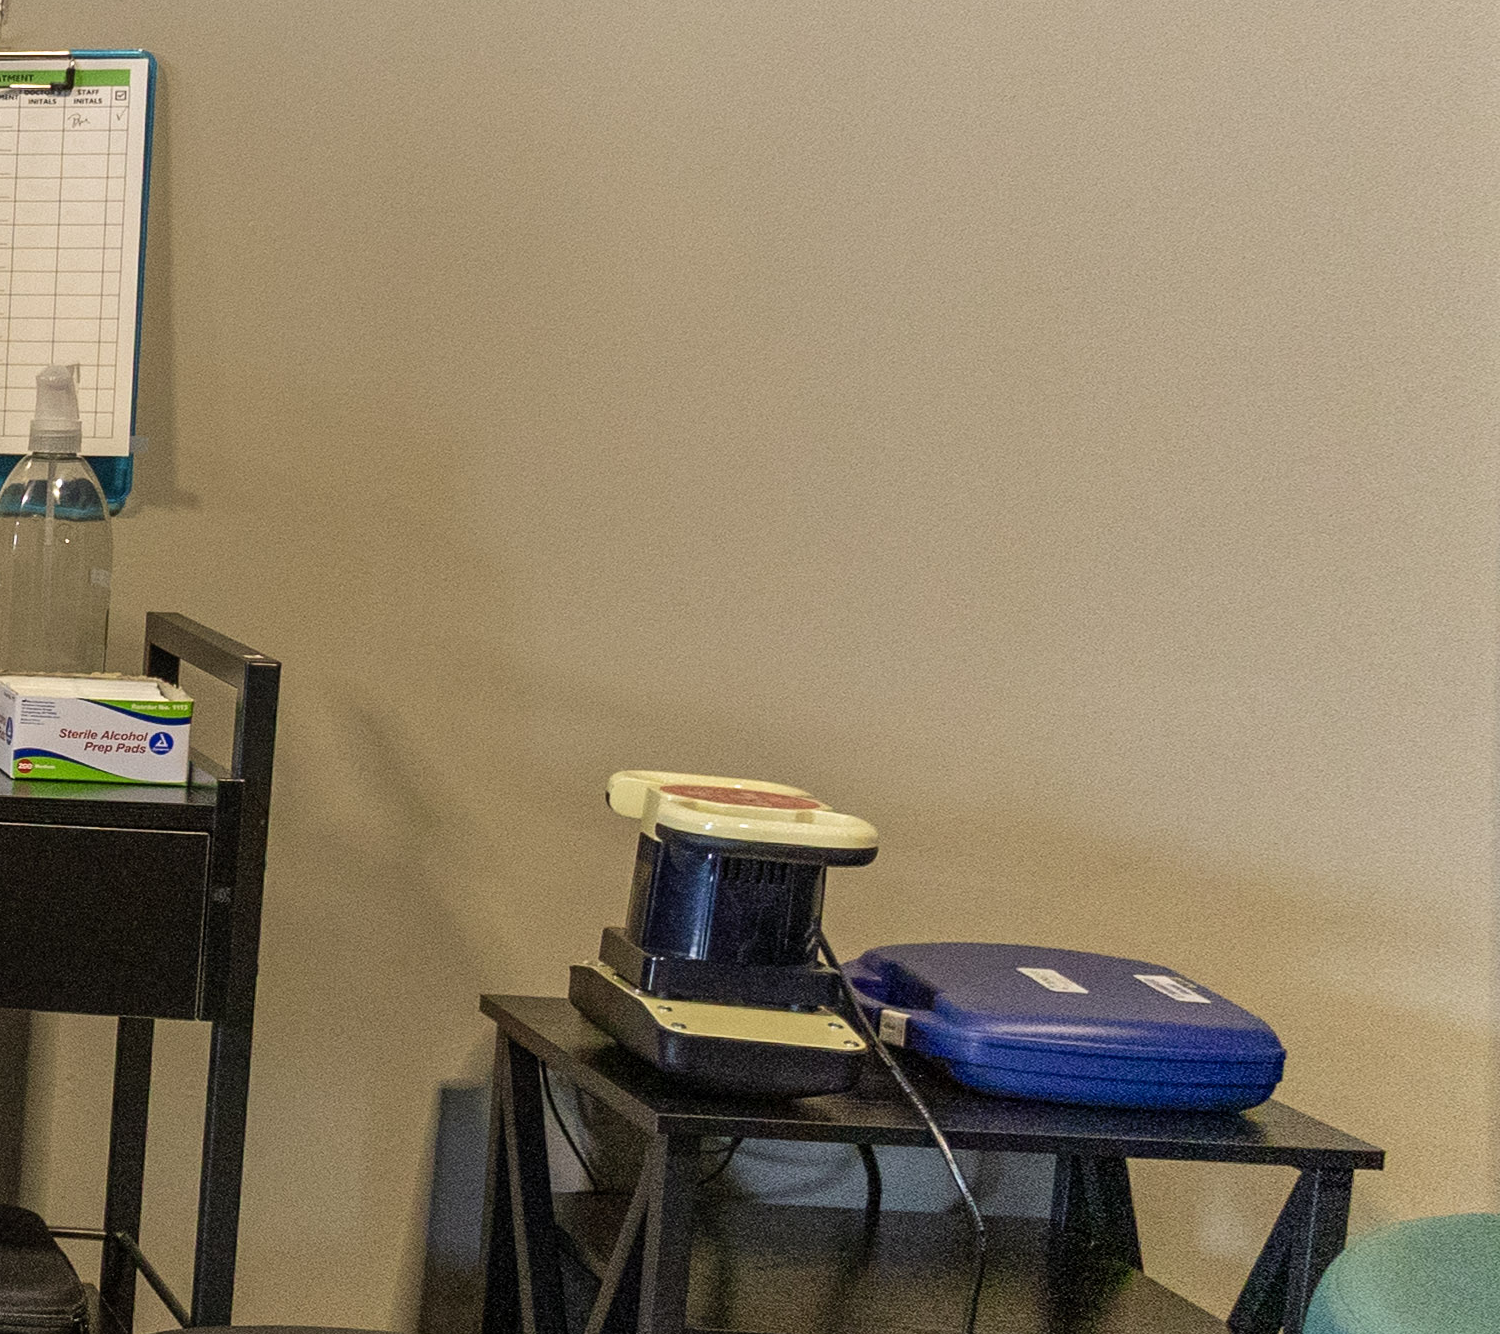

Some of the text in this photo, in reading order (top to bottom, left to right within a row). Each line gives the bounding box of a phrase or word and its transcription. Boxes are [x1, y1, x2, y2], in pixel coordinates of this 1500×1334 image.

[59, 729, 148, 742] Sterile Alcohol
[84, 742, 146, 754] Prep Pads
